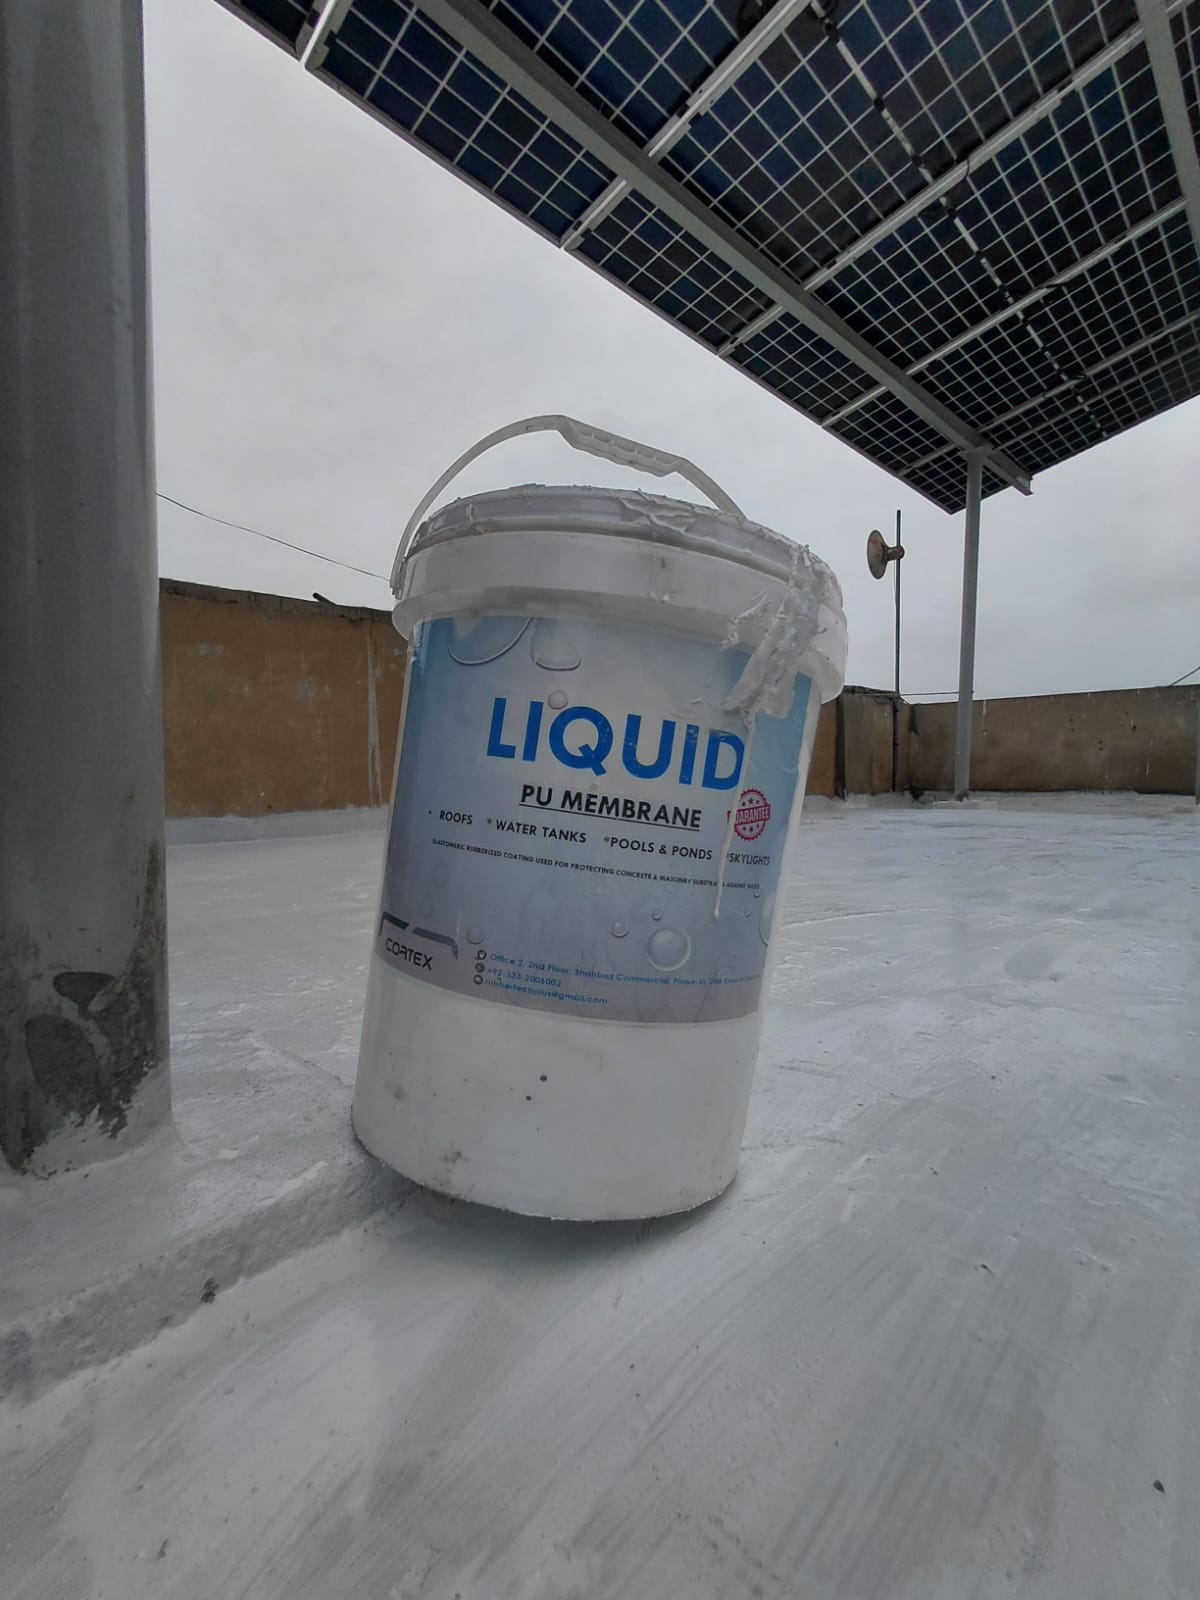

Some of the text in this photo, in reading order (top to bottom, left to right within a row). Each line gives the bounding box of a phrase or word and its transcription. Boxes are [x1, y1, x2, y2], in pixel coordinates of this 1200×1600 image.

[487, 697, 745, 790] LIQUID
[520, 784, 702, 829] PU MEMBRANE
[733, 805, 771, 825] UARANTEE
[439, 810, 473, 825] ROOFS
[496, 819, 537, 836] WATER
[542, 826, 587, 843] TANKS
[659, 844, 667, 855] &
[672, 845, 712, 860] PONDS
[466, 845, 502, 857] RUBBERIZED
[503, 851, 534, 863] COATING
[535, 857, 553, 866] USED
[555, 860, 569, 869] FOR
[571, 863, 614, 875] PROTECTING
[616, 869, 652, 880] CONCRETE
[385, 937, 434, 971] CORTEX
[490, 953, 515, 967] Office
[528, 960, 545, 971] 2nd
